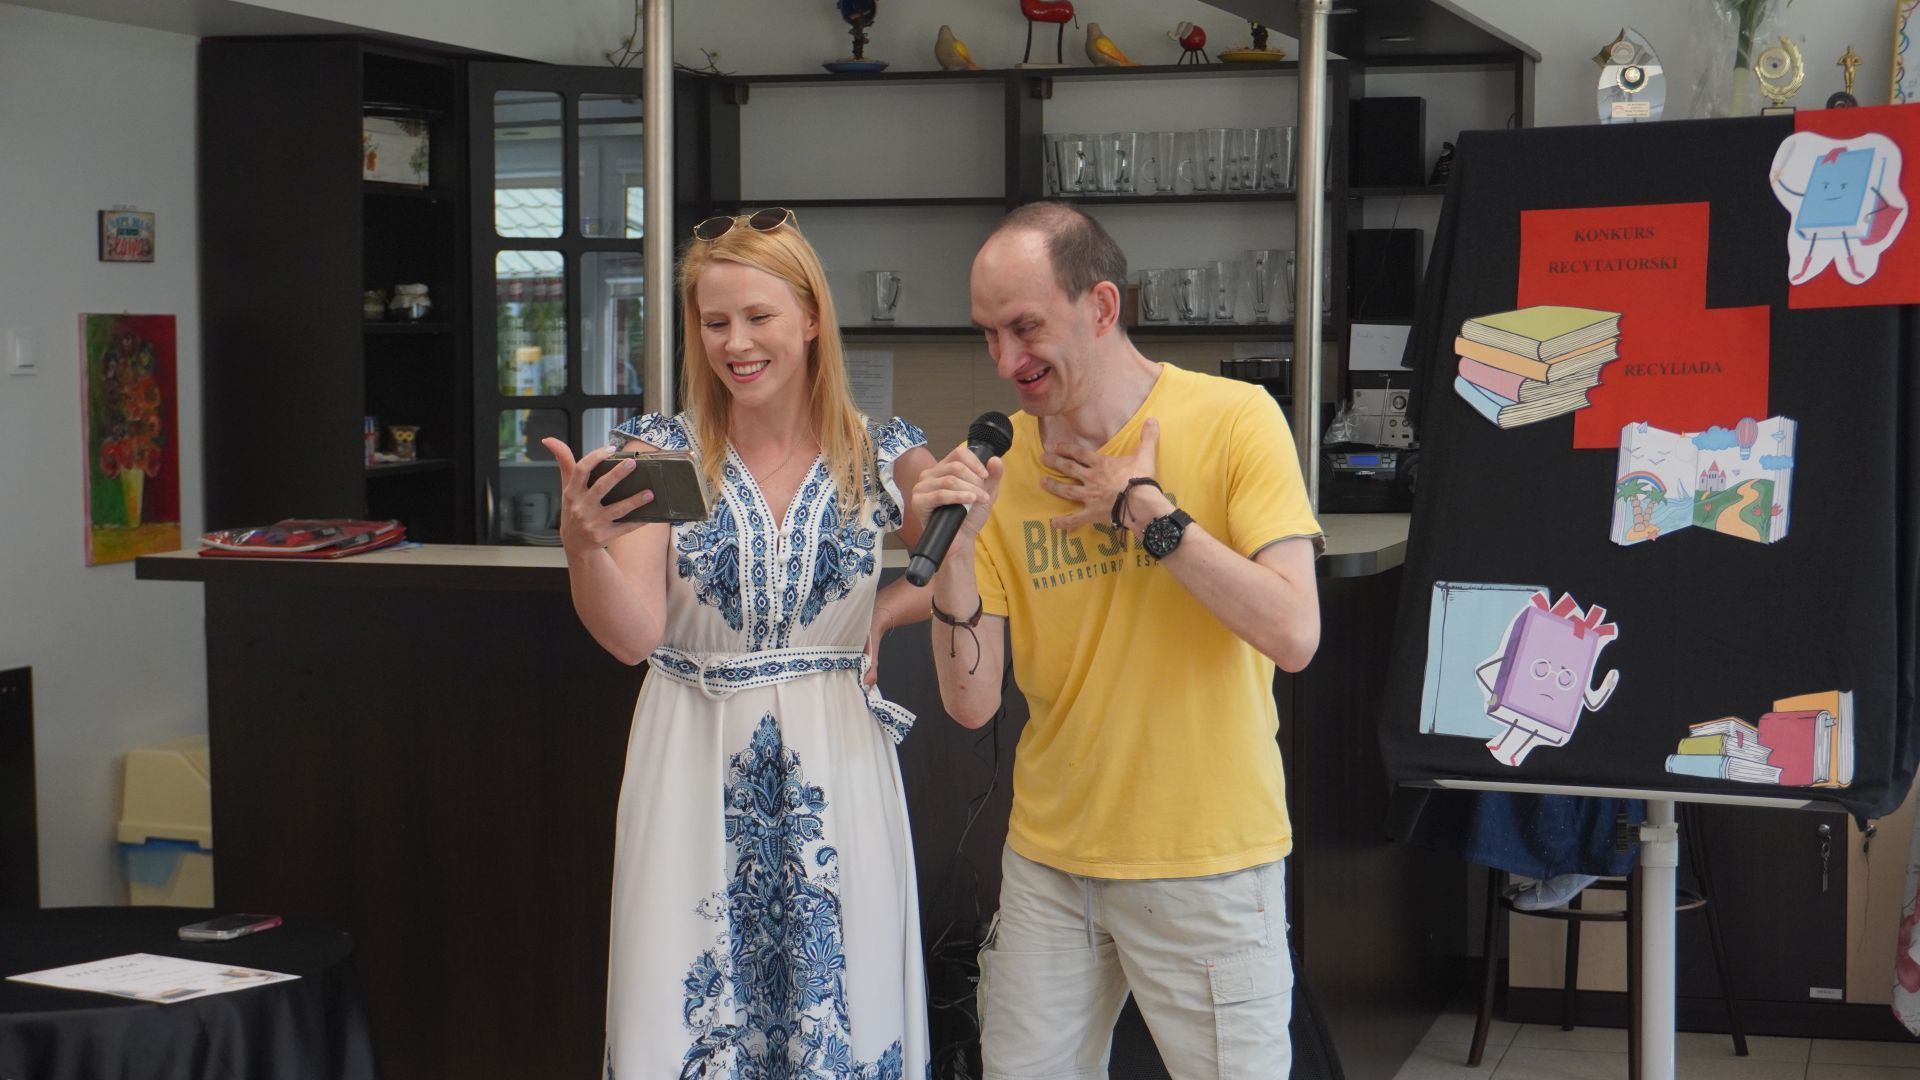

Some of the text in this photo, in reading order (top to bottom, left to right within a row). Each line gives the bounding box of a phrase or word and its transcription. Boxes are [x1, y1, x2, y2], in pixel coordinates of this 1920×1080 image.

[1574, 227, 1655, 242] KONKURS
[1548, 257, 1679, 273] RECYTATORSKI
[1624, 361, 1722, 377] RECYLIADA
[1023, 519, 1087, 574] BIG
